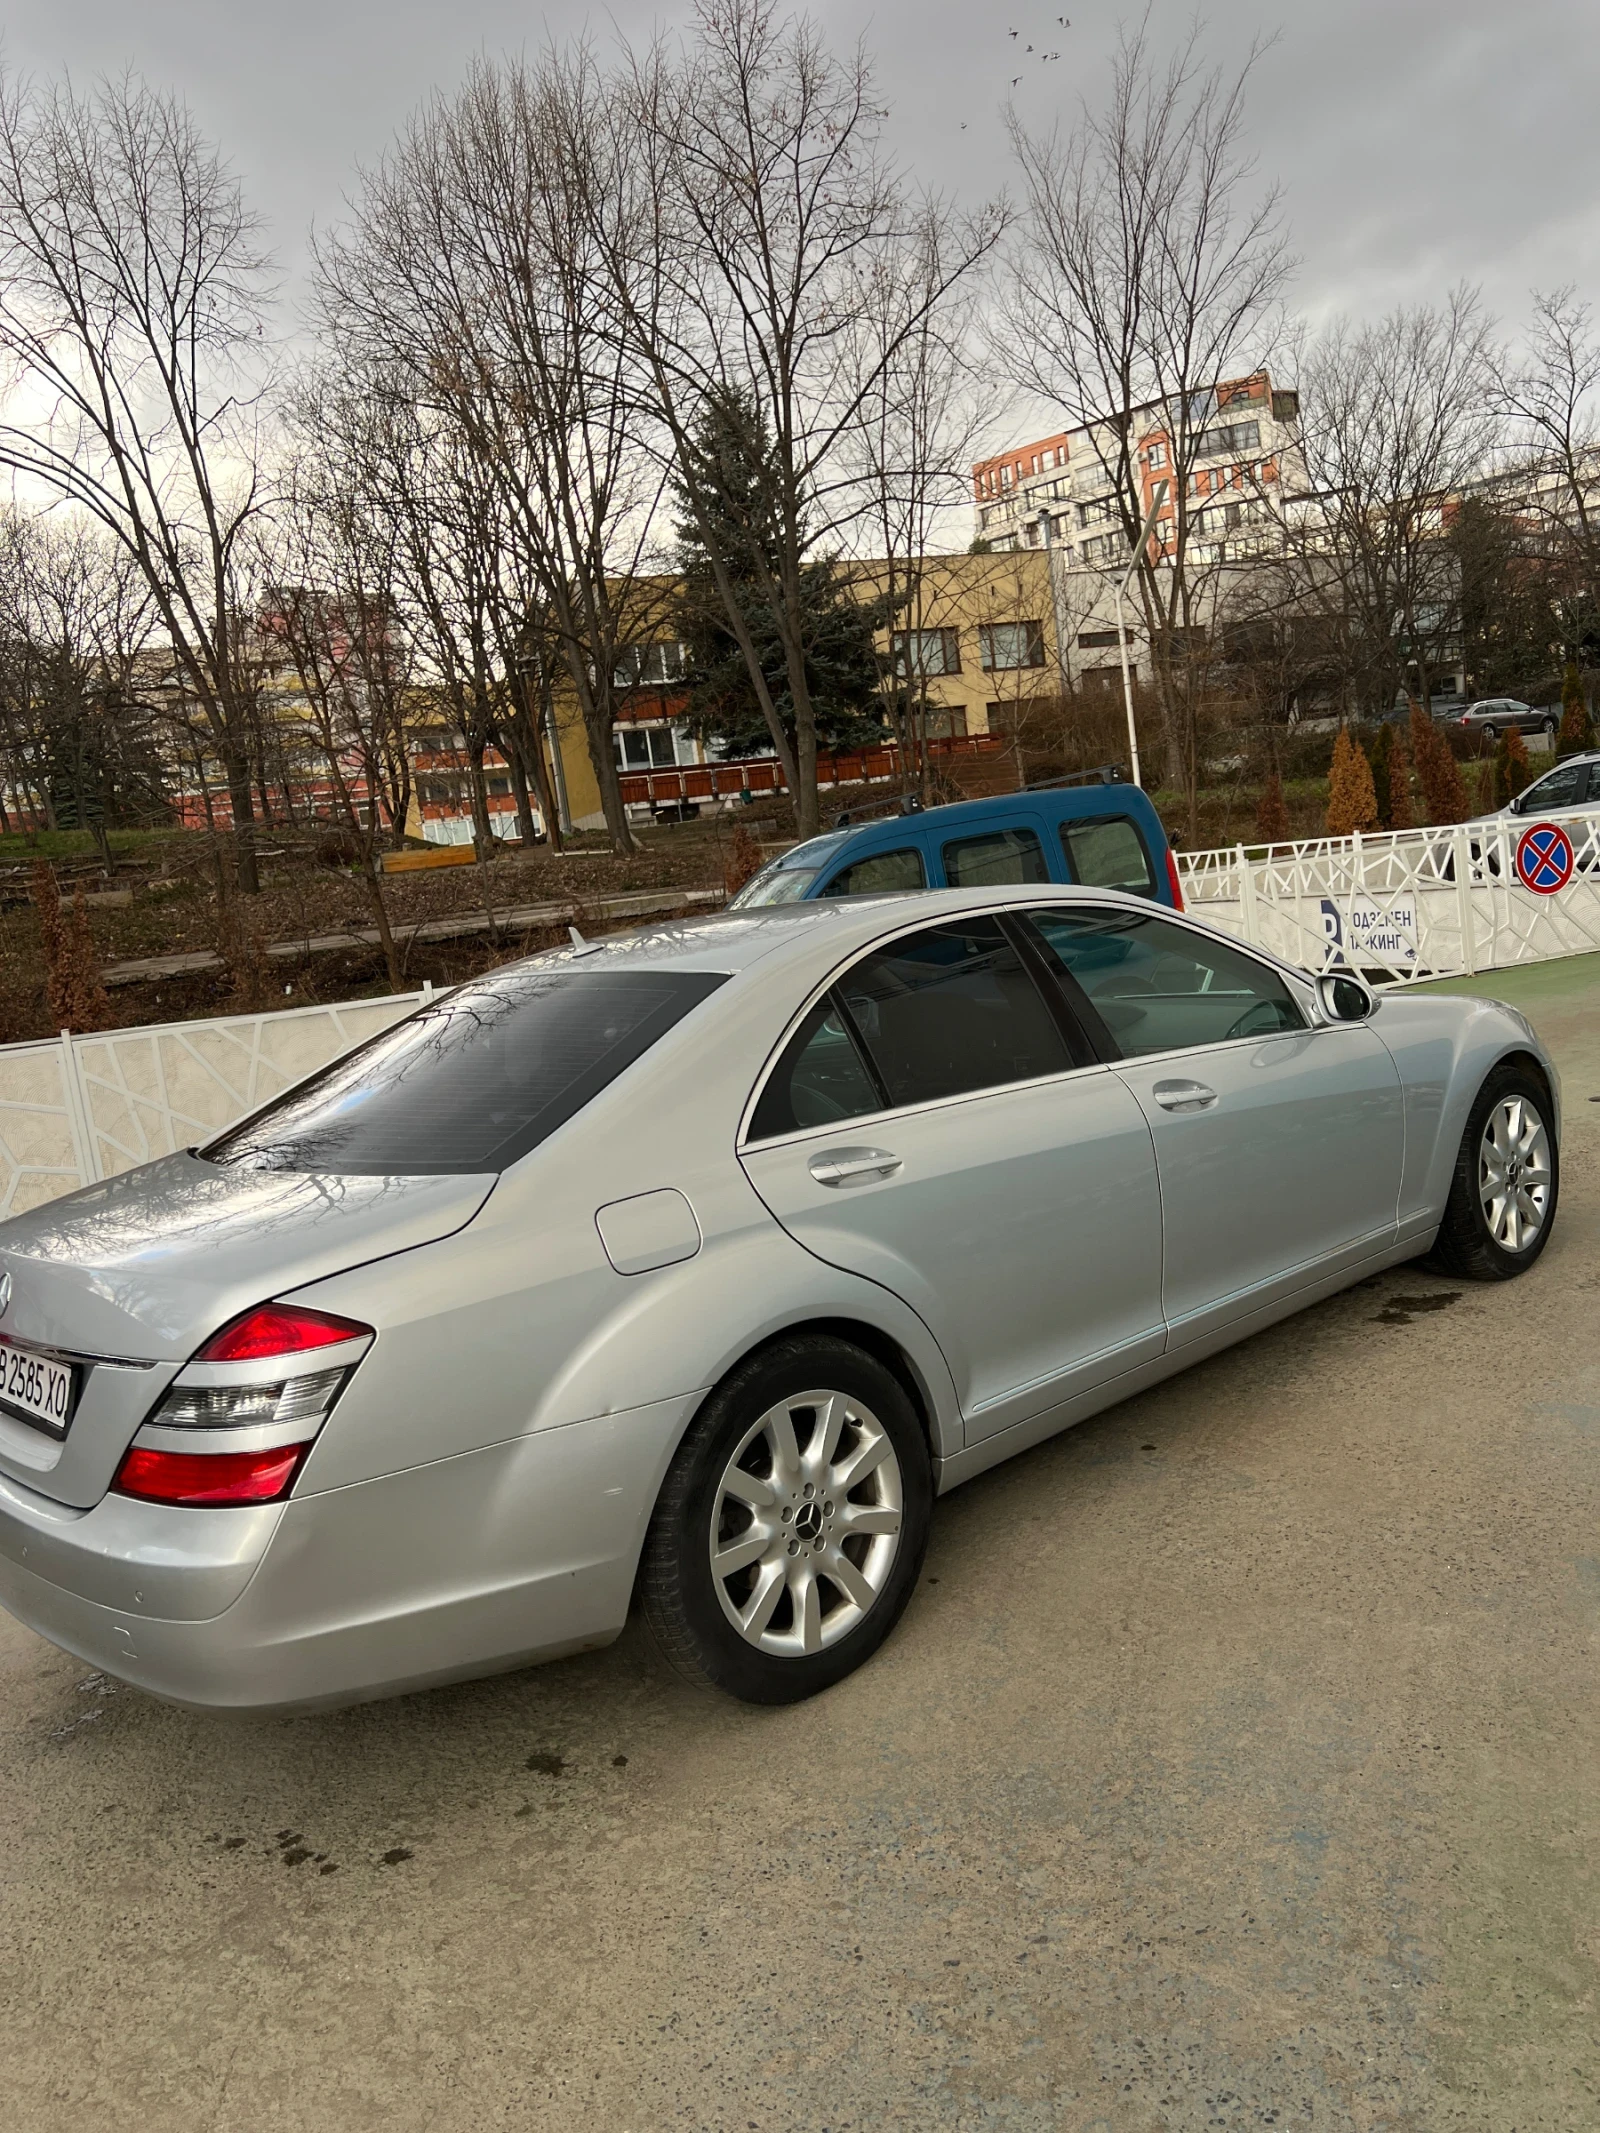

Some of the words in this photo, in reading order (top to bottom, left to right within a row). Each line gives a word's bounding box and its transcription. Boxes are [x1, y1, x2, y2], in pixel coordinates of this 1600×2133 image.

[1345, 911, 1411, 929] ОДЗЕН
[1349, 934, 1402, 949] ПКИНГ
[8, 1354, 44, 1406] 2585
[45, 1367, 66, 1417] XO
